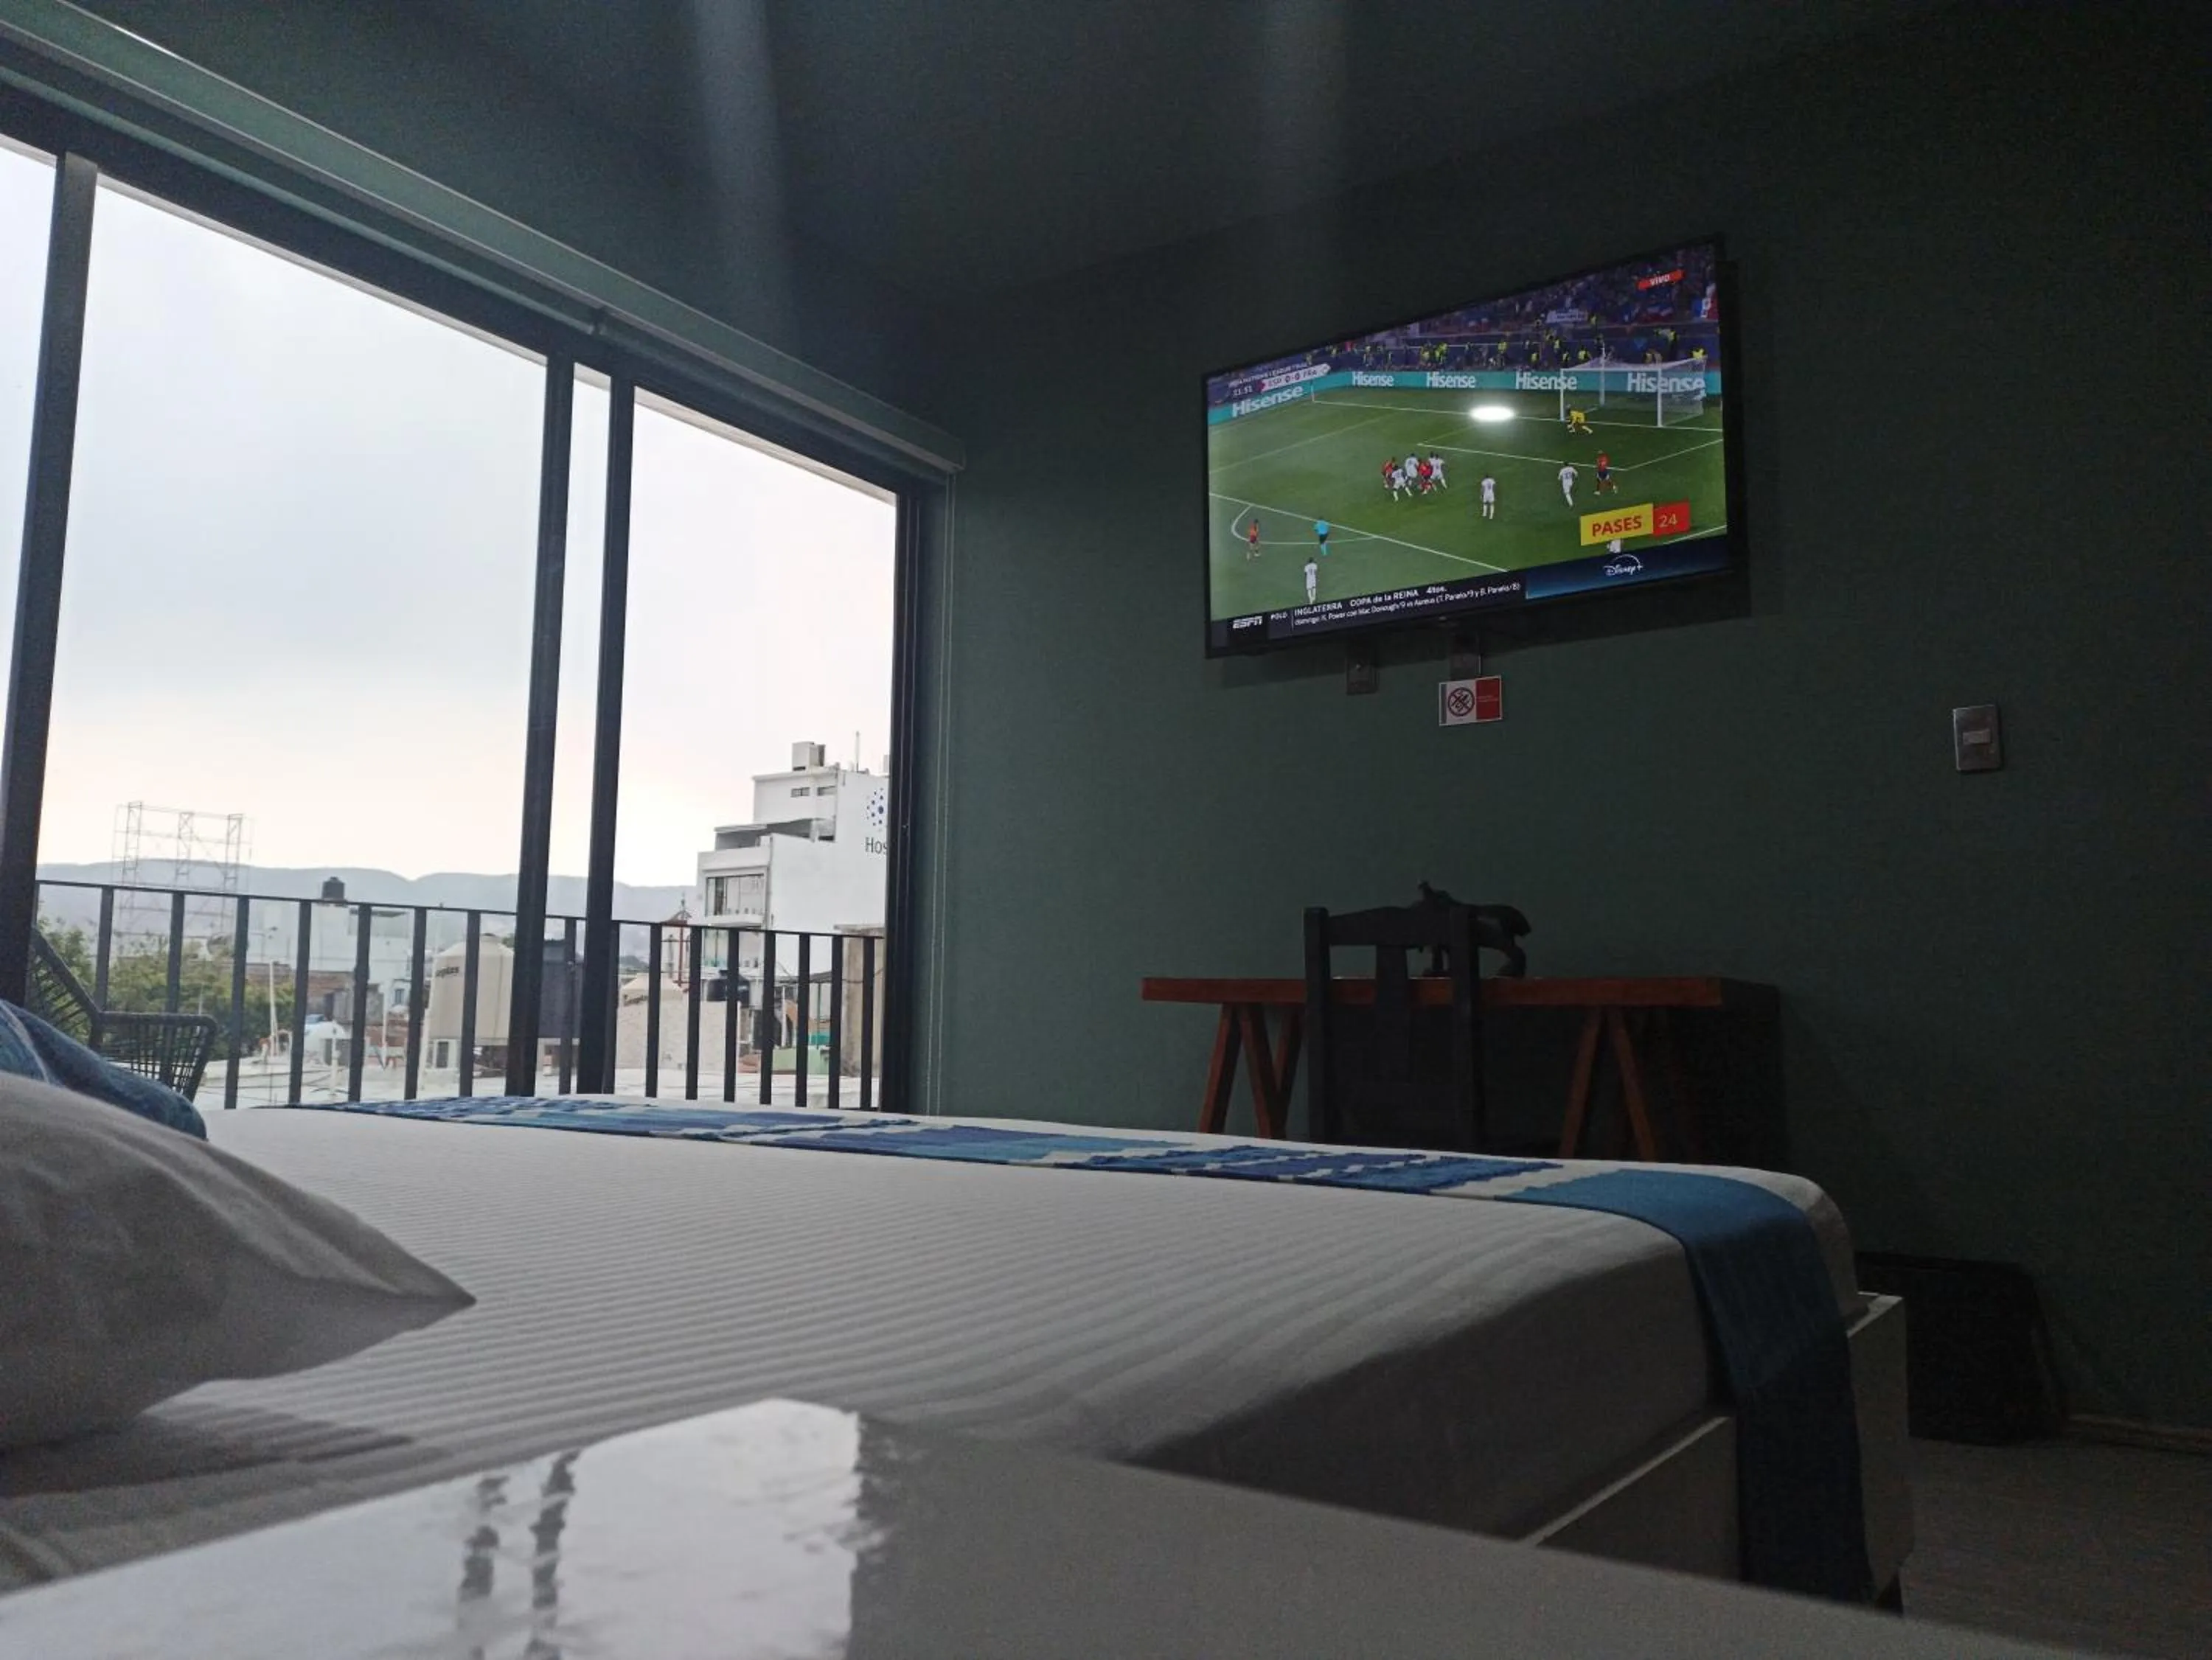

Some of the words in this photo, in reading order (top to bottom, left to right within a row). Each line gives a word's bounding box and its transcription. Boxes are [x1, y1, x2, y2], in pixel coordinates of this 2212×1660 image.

[1352, 372, 1394, 386] Hisense
[1426, 372, 1475, 388] Hisense
[1515, 372, 1578, 390] Hisense
[1627, 372, 1705, 393] Hisense
[1232, 386, 1304, 417] Hisense
[1592, 515, 1643, 537] PASES
[1659, 514, 1677, 528] 24
[1294, 601, 1343, 616] INGLATERRA
[1350, 597, 1372, 607] COPA
[1393, 590, 1419, 599] REINA
[1232, 615, 1263, 629] ESPN
